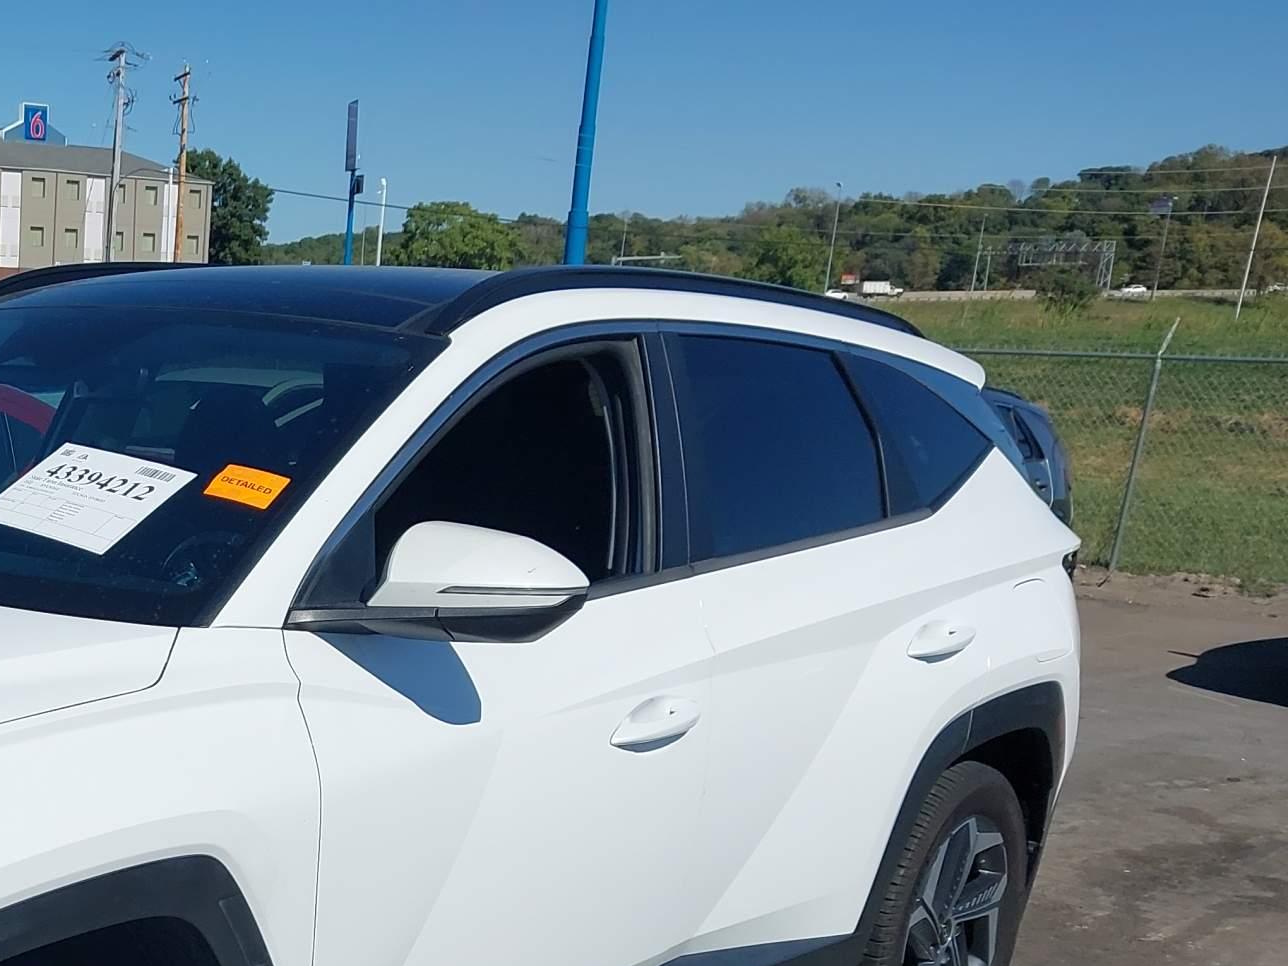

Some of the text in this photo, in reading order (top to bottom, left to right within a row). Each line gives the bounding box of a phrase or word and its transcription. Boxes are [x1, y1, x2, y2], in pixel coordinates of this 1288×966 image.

[30, 111, 45, 139] 6
[45, 463, 155, 501] 43394212
[220, 475, 273, 495] DETAILED
